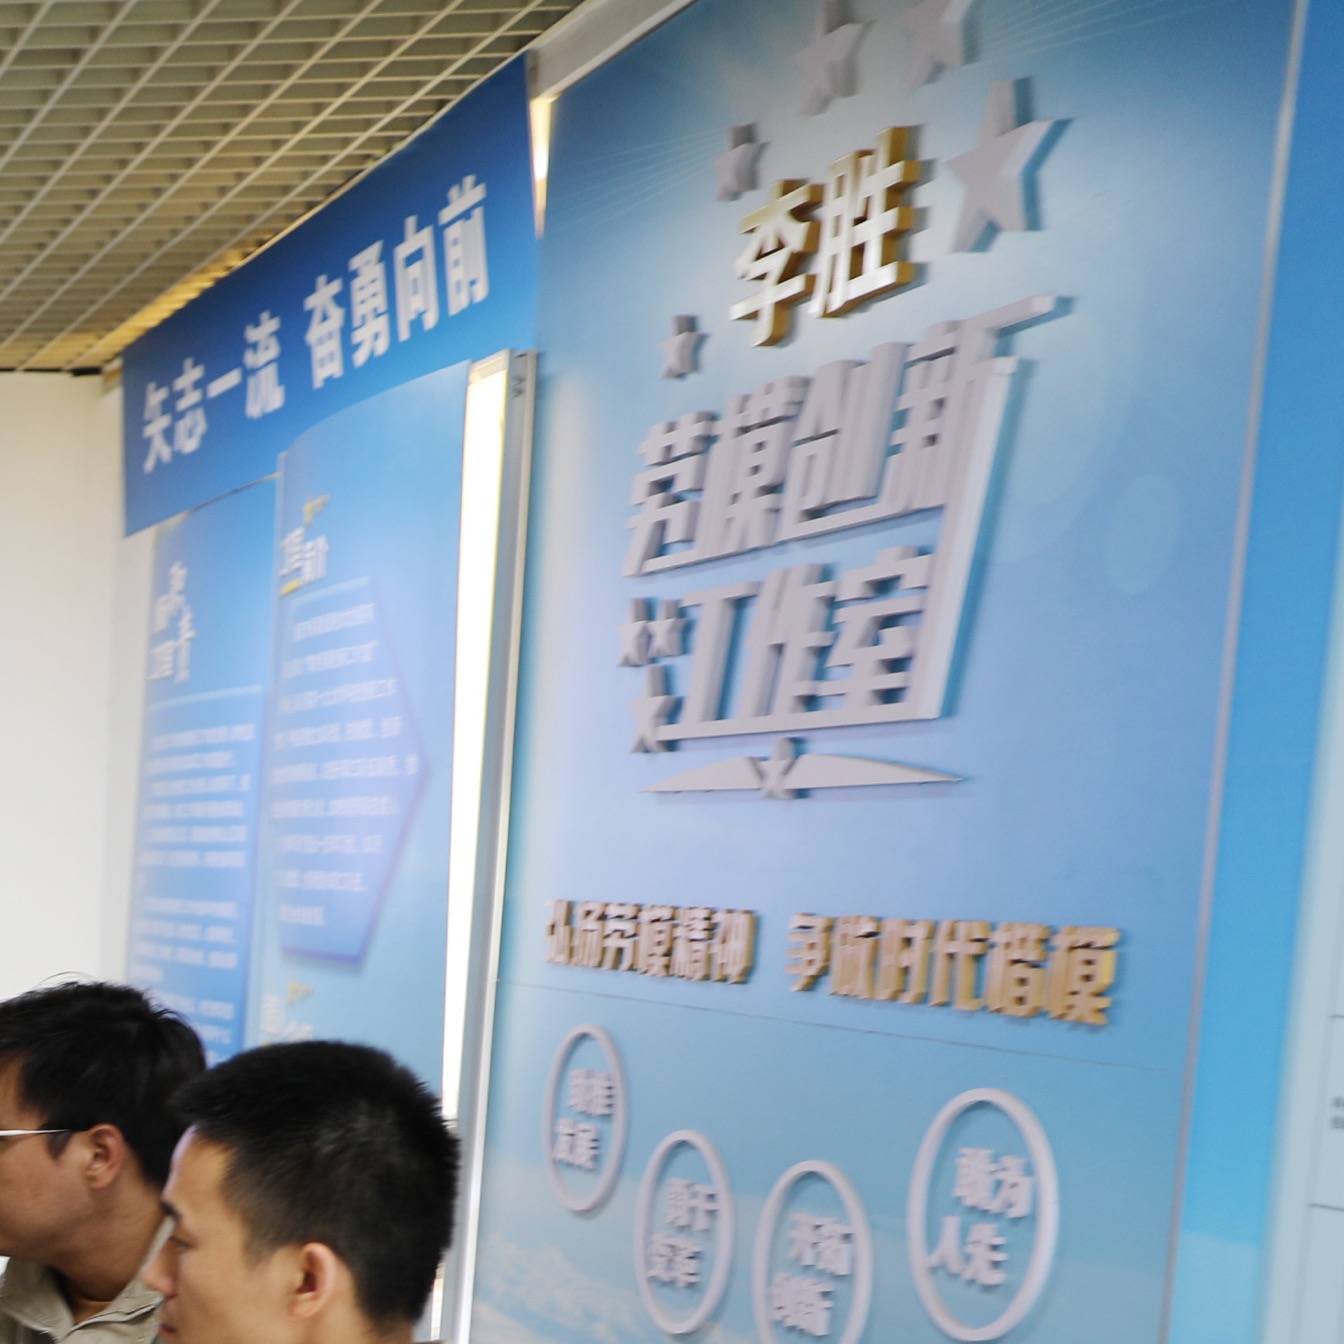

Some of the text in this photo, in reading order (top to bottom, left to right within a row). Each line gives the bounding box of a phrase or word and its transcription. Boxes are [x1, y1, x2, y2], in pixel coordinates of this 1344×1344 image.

[142, 174, 492, 475] 矢志一流 奋勇向前
[730, 126, 914, 347] 李胜
[622, 297, 1054, 578] 劳模创新
[657, 545, 932, 738] 工作室
[545, 899, 757, 985] 弘扬劳模精神
